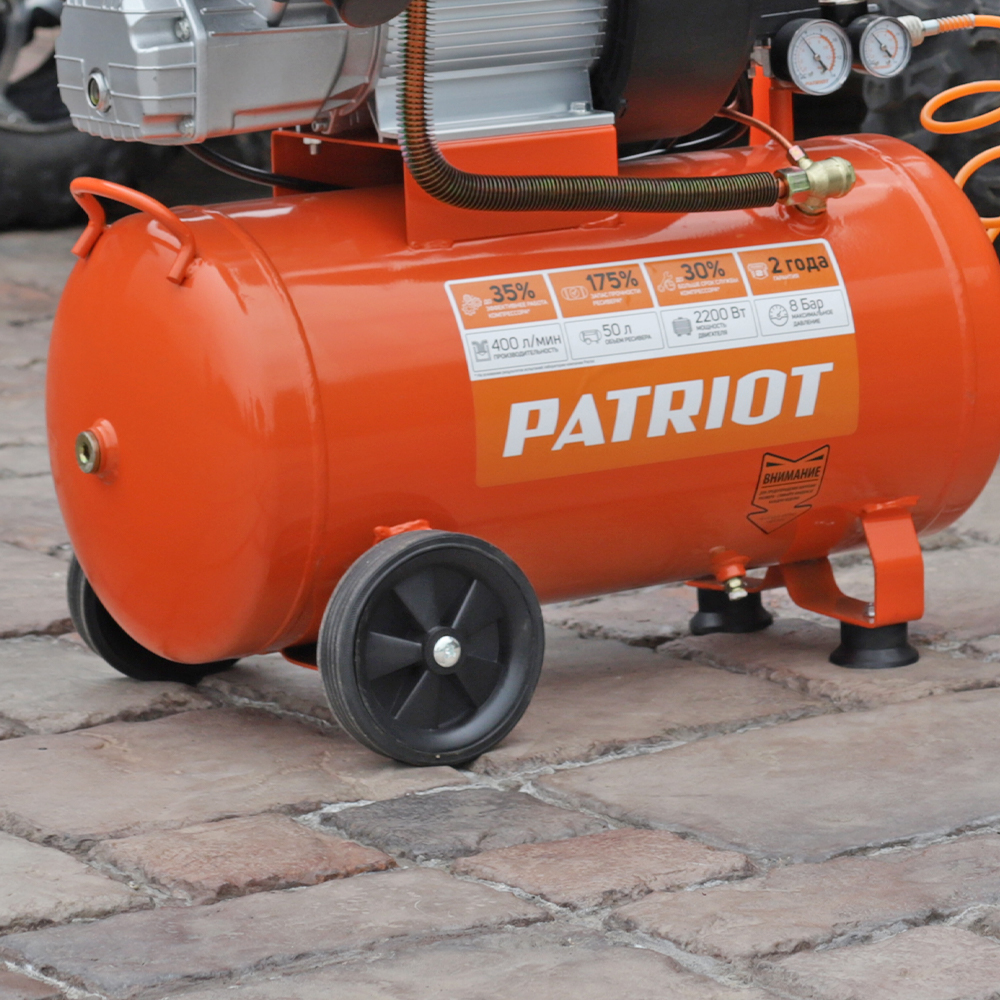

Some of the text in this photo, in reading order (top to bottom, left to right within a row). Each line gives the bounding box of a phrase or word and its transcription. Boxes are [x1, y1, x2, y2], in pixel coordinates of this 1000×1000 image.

[681, 260, 726, 281] 30%
[768, 255, 829, 274] 2 года
[586, 269, 639, 291] 175%
[489, 282, 536, 303] 35%
[789, 297, 824, 312] 8 Бар
[693, 306, 746, 323] 2200 Вт
[791, 309, 833, 319] МАКСИМАЛЬНОЕ
[602, 322, 632, 337] 50 л
[696, 322, 727, 331] МОЩНОСТЬ
[793, 318, 821, 328] ДАВЛЕНИЕ
[491, 334, 562, 351] 400 л/мин
[698, 330, 728, 339] ДВИГАТЕЛЯ
[493, 347, 559, 360] ПРОИЗВОДИТЕЛЬНОСТЬ
[502, 362, 834, 458] PATRIOT
[763, 466, 821, 484] ВНИМАНИЕ
